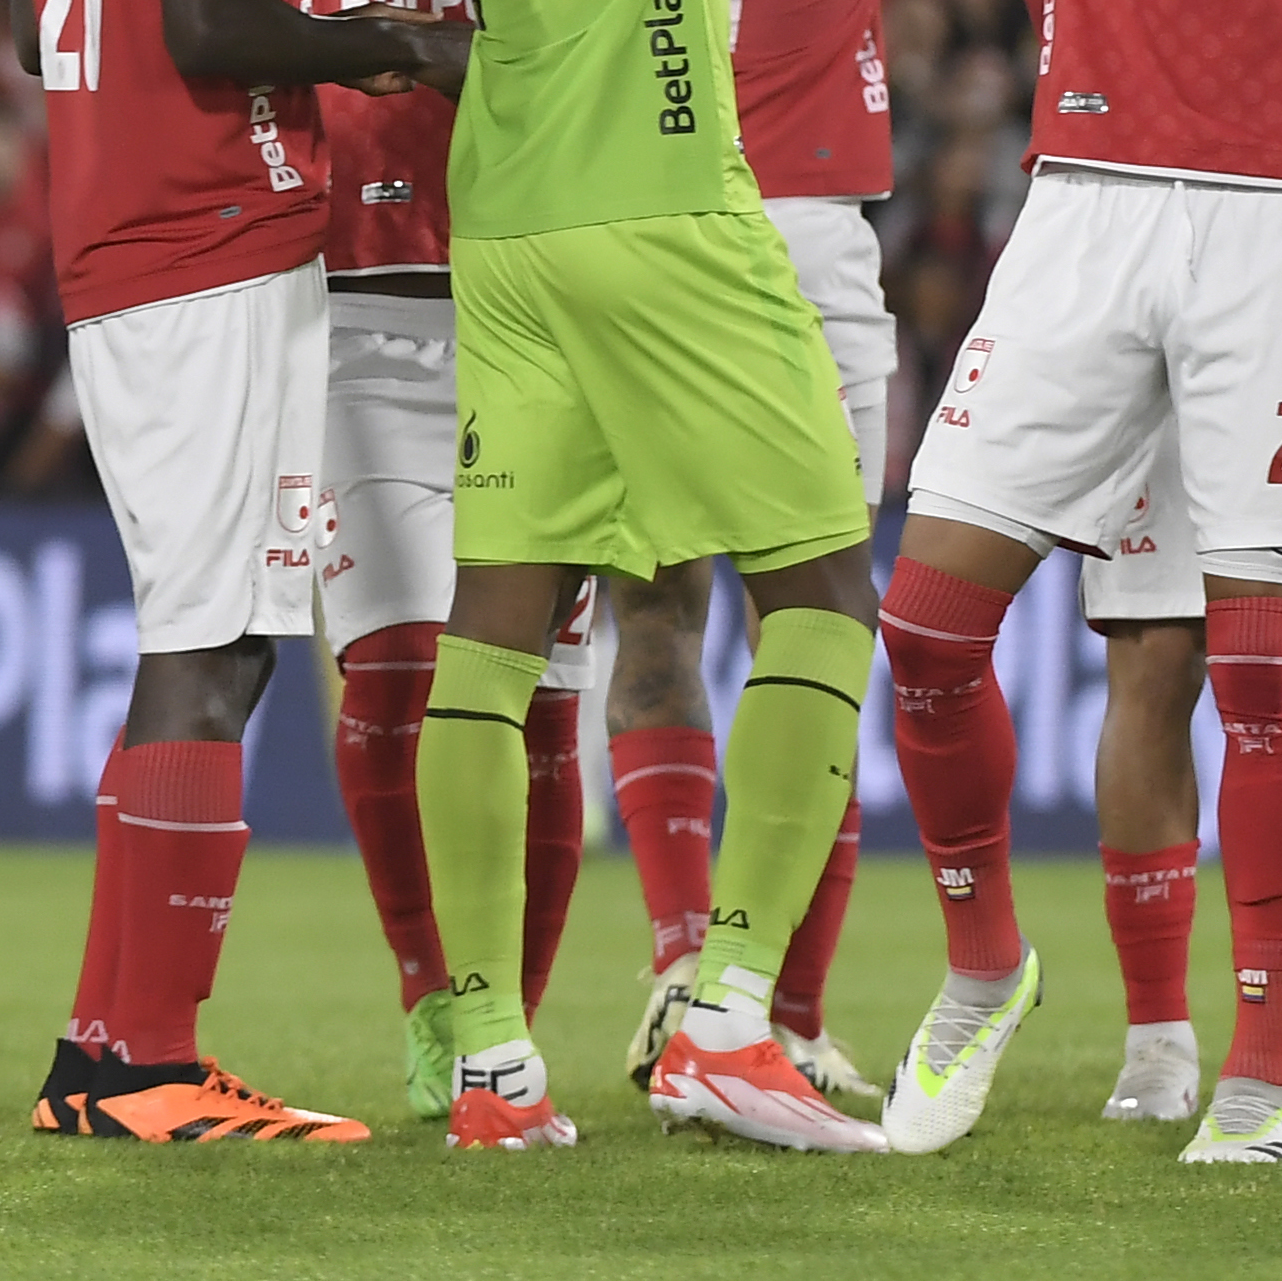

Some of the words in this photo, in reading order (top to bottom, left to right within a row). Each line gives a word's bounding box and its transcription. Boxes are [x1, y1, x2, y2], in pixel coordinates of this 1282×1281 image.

[936, 405, 970, 428] FILA
[266, 548, 310, 568] FILA
[936, 867, 975, 887] JM
